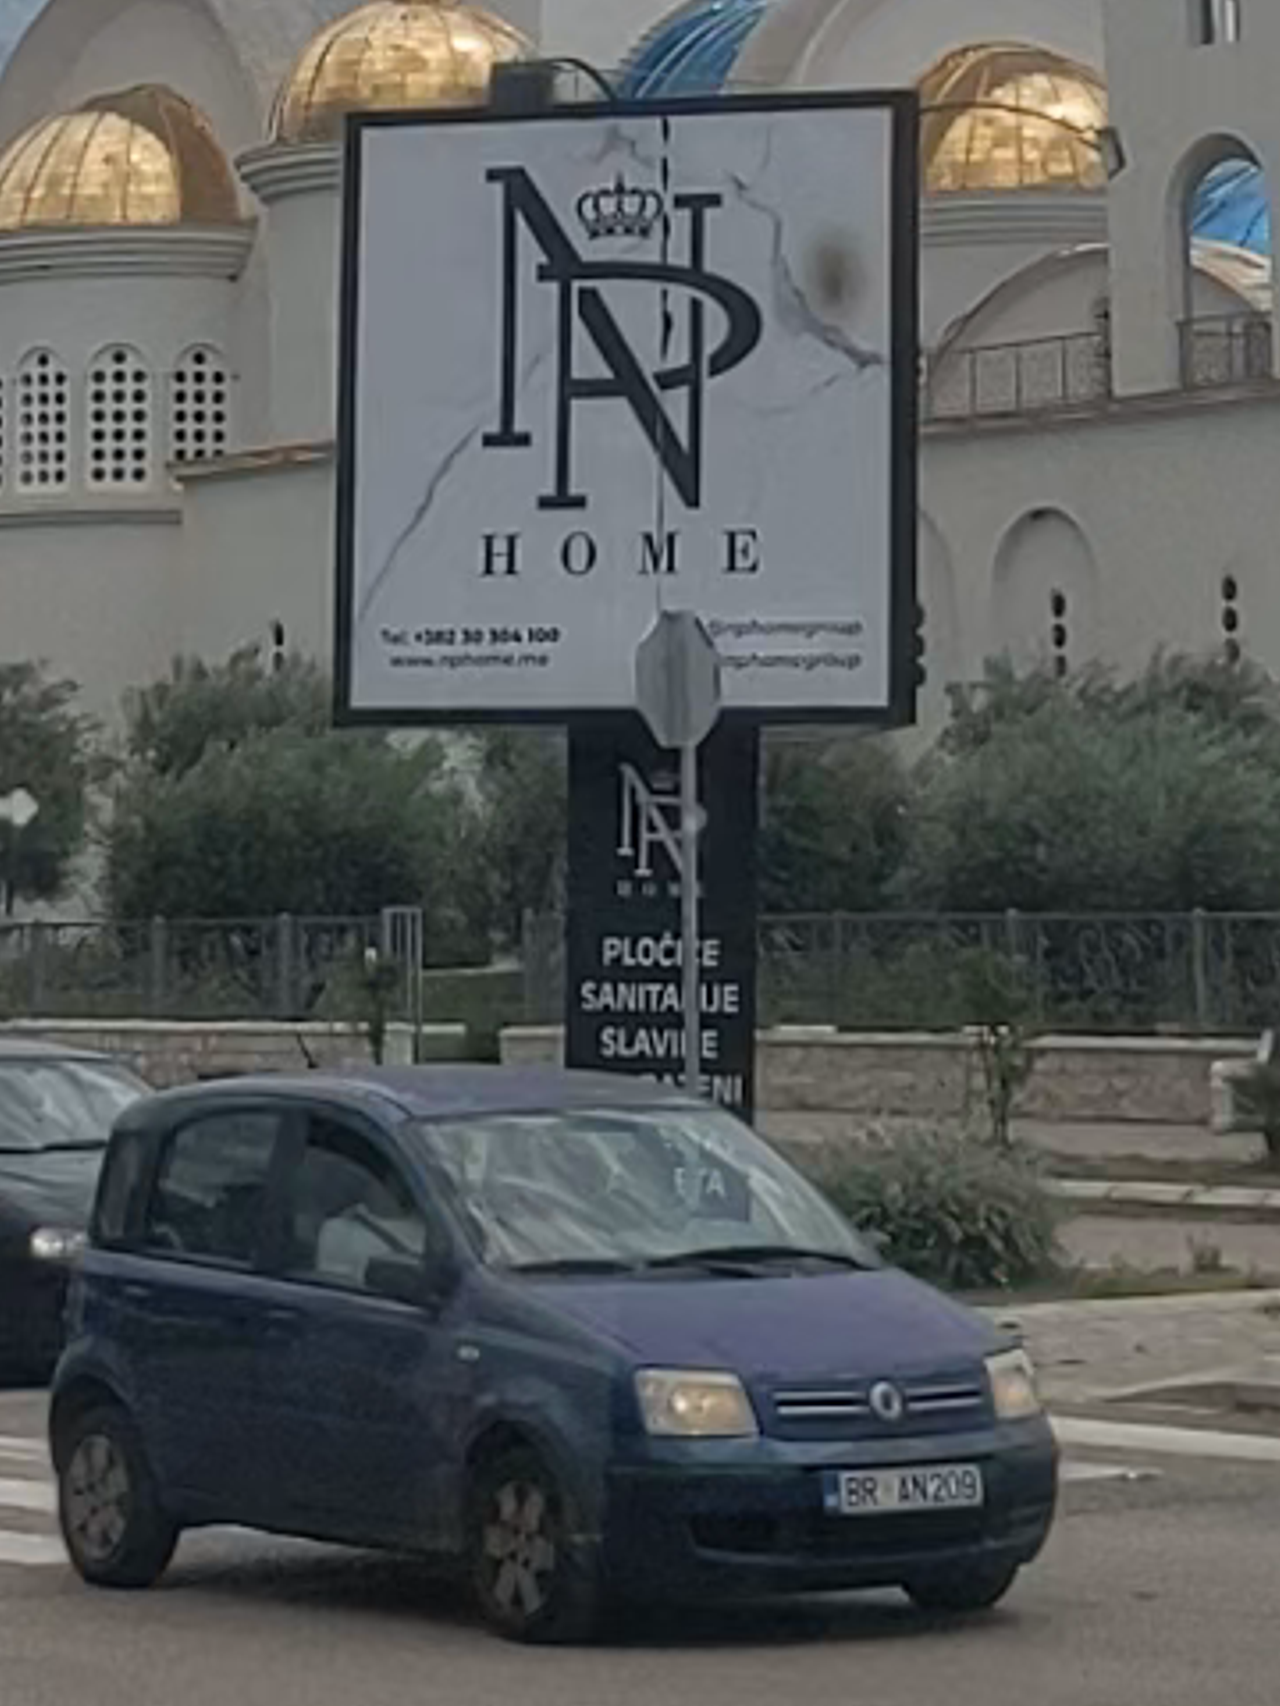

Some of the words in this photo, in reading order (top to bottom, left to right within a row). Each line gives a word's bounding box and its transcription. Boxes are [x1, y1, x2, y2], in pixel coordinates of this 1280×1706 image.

[480, 529, 761, 577] HOME
[602, 930, 721, 967] PLOČIE
[580, 981, 740, 1014] SANITAIJE
[846, 1475, 878, 1507] BR
[897, 1469, 978, 1504] AN209
